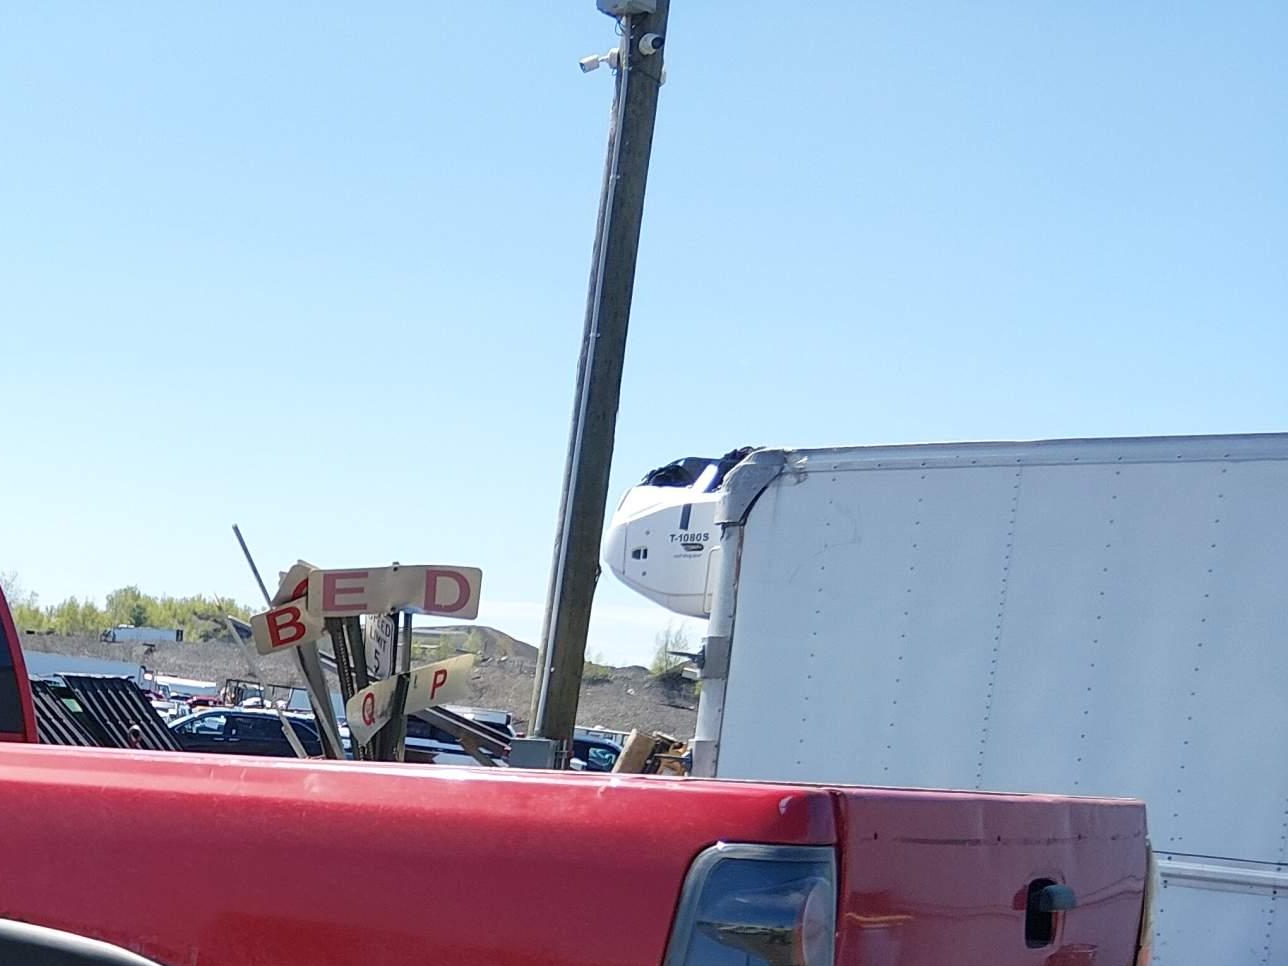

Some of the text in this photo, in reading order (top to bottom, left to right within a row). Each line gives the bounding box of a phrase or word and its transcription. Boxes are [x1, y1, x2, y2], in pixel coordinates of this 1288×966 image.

[669, 533, 710, 543] T-1080S
[322, 571, 369, 612] E
[423, 569, 471, 613] D
[266, 606, 307, 648] B
[372, 643, 381, 673] 5
[362, 668, 448, 726] Q P
